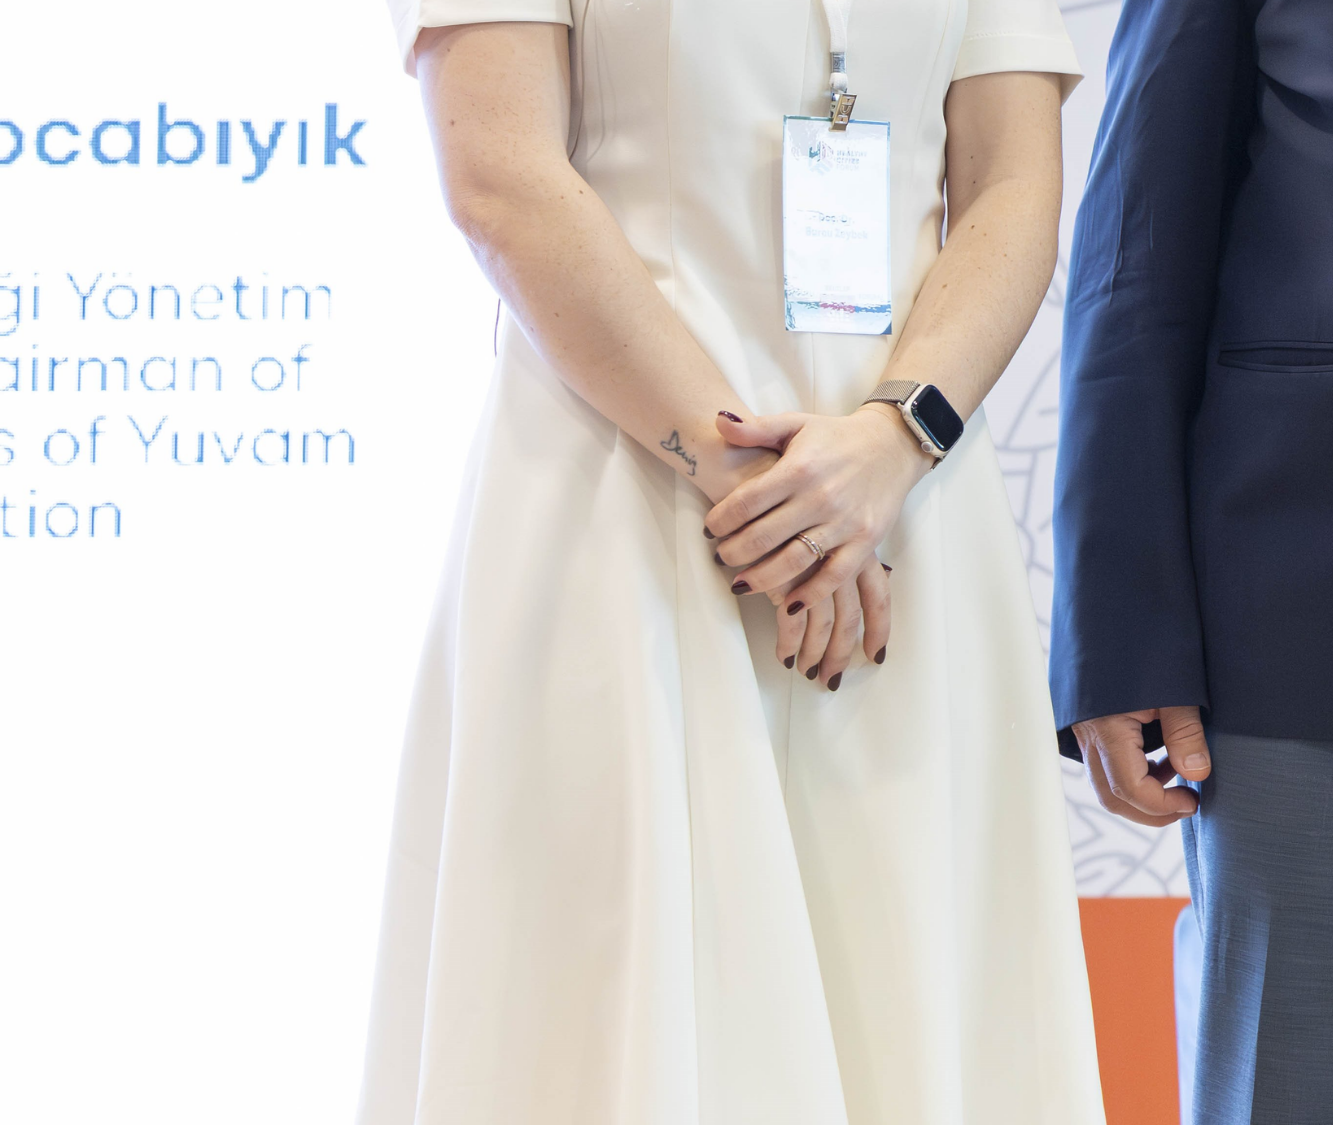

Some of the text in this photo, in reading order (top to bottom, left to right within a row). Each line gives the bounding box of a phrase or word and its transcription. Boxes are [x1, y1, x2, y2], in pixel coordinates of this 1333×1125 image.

[66, 272, 332, 320] Yönetim
[251, 344, 312, 391] of
[43, 415, 107, 465] of
[127, 415, 355, 465] Yuvam
[0, 489, 121, 538] tion
